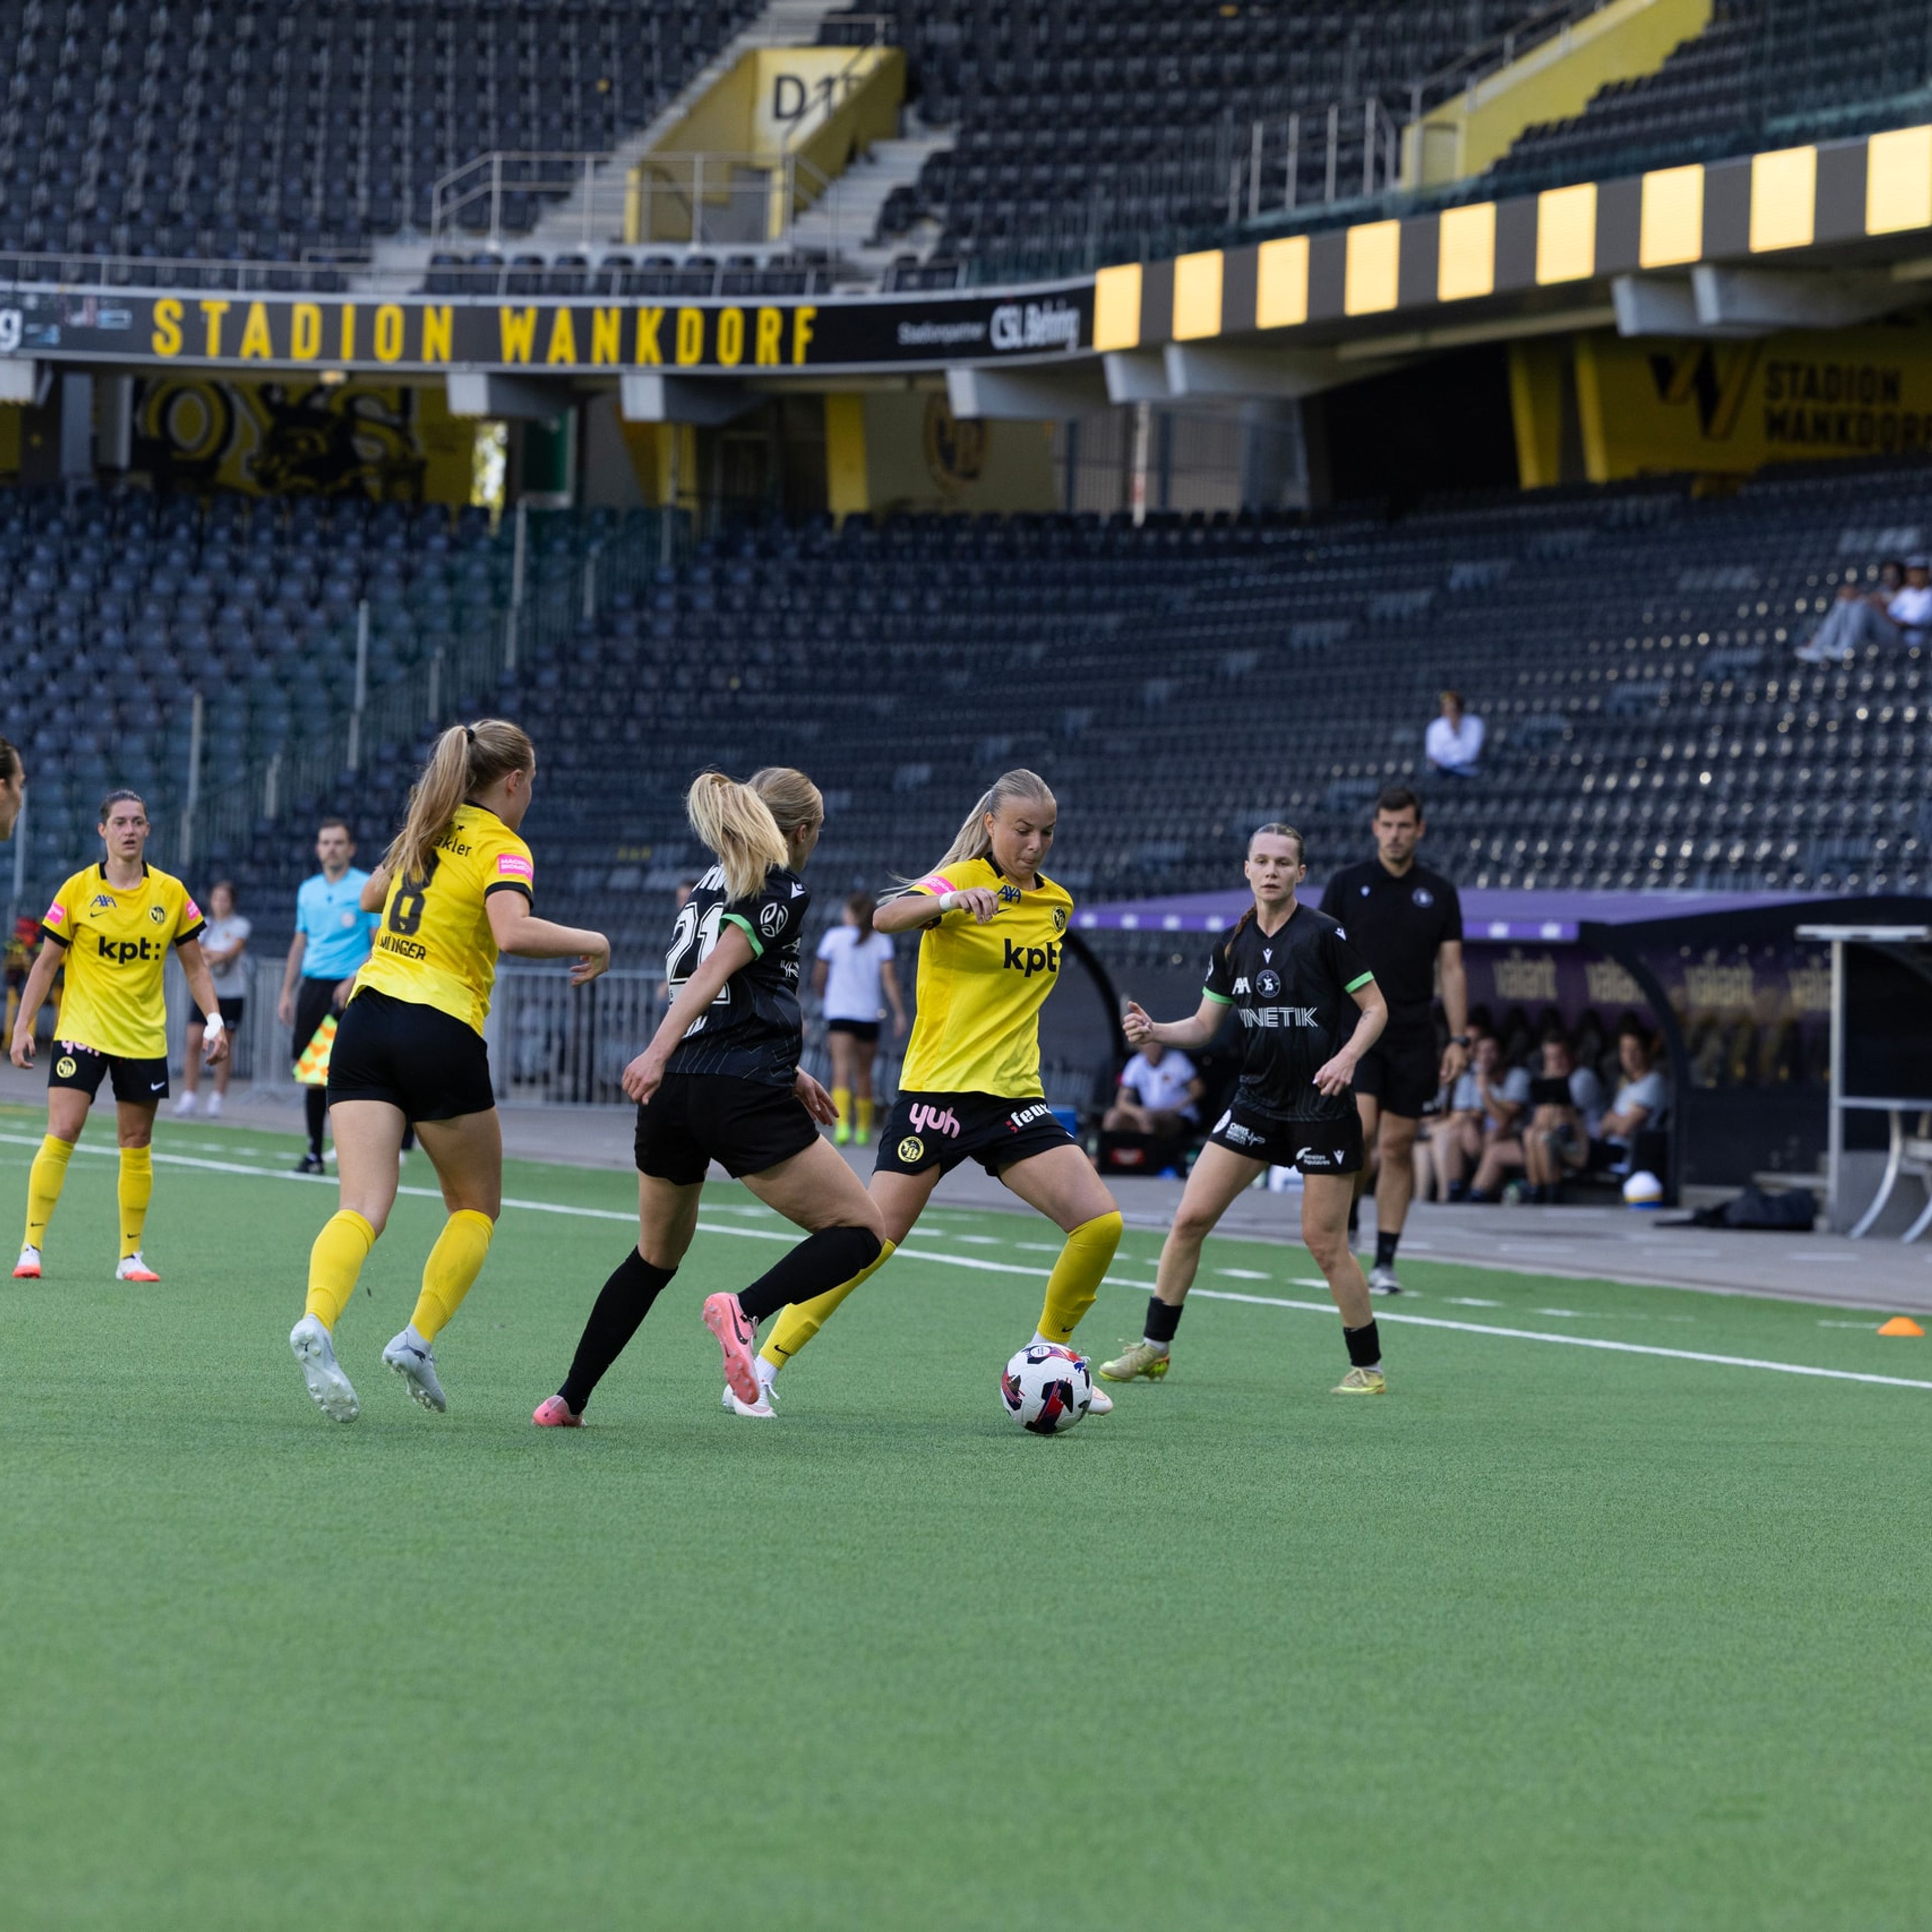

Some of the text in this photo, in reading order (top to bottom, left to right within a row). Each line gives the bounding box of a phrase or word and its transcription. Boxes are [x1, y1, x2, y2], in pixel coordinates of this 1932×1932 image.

[151, 297, 818, 367] STADION WANKDORF
[90, 895, 117, 908] AXA
[388, 847, 441, 937] 8
[998, 884, 1022, 904] AXA
[665, 902, 731, 1007] 21
[1003, 938, 1057, 978] kpt
[909, 1103, 960, 1139] yuh
